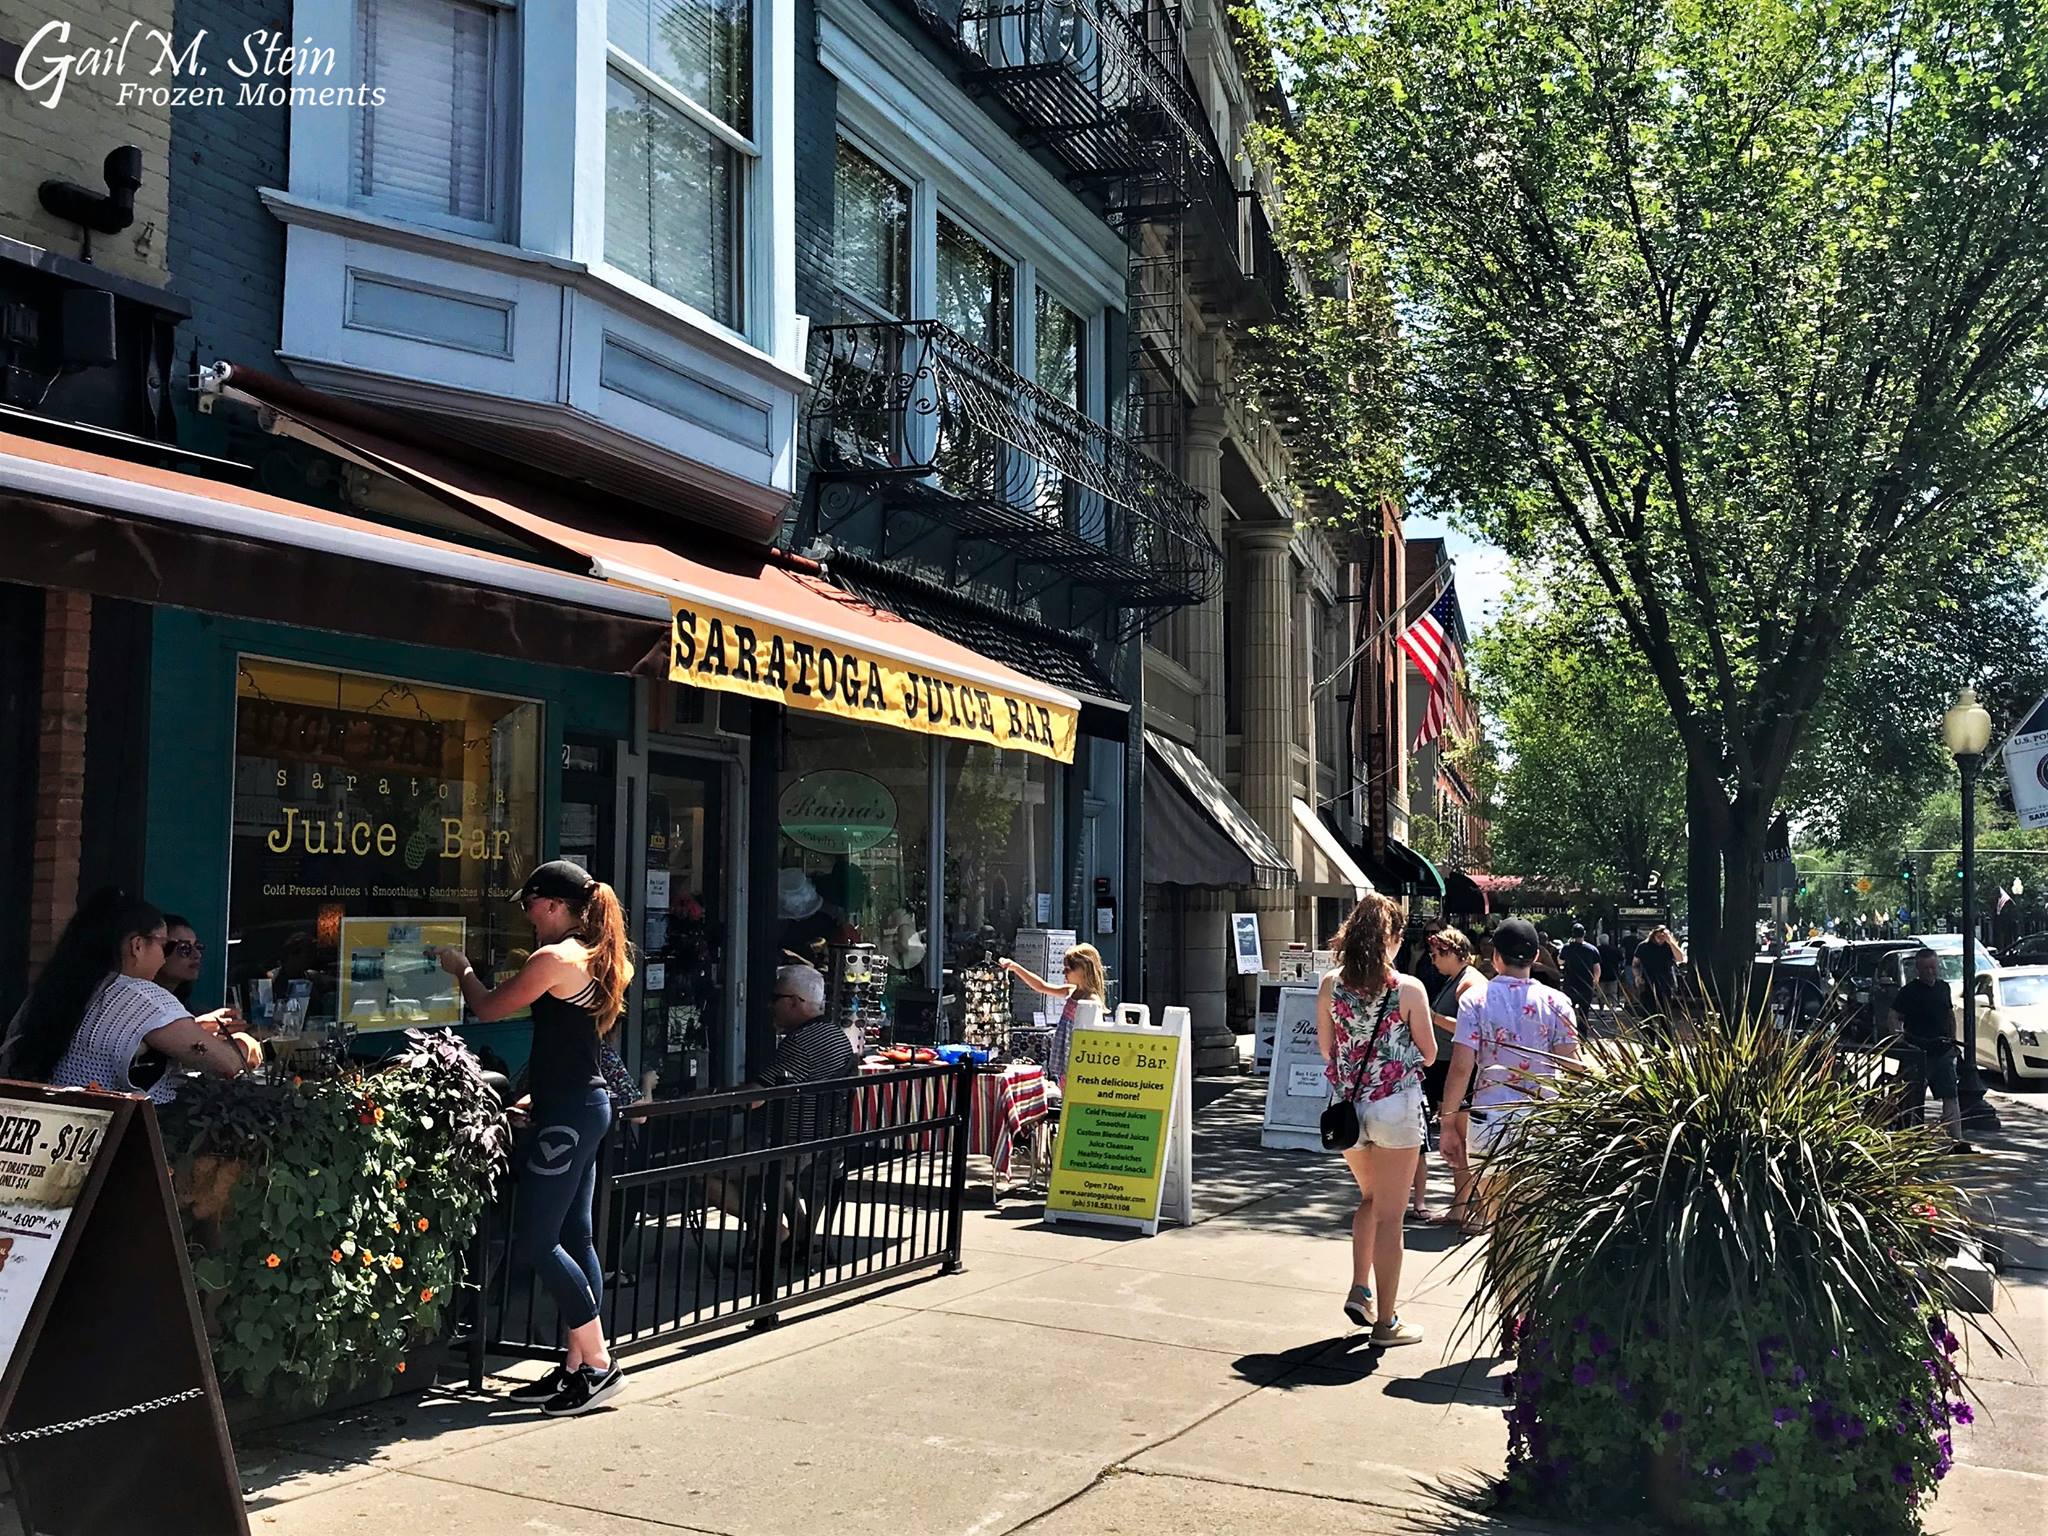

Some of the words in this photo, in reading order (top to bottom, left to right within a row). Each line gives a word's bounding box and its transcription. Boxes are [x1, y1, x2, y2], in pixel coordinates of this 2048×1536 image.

[674, 608, 887, 711] SARATOGA
[904, 671, 995, 735] JUICE
[1008, 697, 1055, 749] BAR
[786, 796, 886, 819] Raina's
[268, 807, 397, 856] Juice
[440, 817, 510, 860] Bar
[263, 883, 286, 896] Cold
[289, 884, 328, 896] Pressed
[330, 884, 361, 896] Juices
[372, 885, 419, 897] Smoothies
[429, 886, 478, 898] Sandwiches
[1081, 1039, 1168, 1052] saratoga
[1075, 1050, 1120, 1066] Juice
[1077, 1075, 1100, 1085] Fresh
[1101, 1077, 1138, 1089] delicious
[1097, 1090, 1114, 1099] and
[1115, 1092, 1141, 1101] more!
[1085, 1107, 1100, 1116] Cold
[1101, 1109, 1127, 1118] Pressed
[1127, 1111, 1147, 1120] Juices
[1095, 1119, 1130, 1129] Smoothies
[1076, 1128, 1101, 1137] Custom
[1102, 1130, 1129, 1139] Blended
[1129, 1133, 1150, 1142] Juices
[51, 1124, 99, 1164] $14
[1088, 1140, 1106, 1148] Juice
[1106, 1141, 1135, 1151] Cleanses
[1077, 1150, 1103, 1159] Healthy
[1103, 1152, 1142, 1162] Sandwiches
[6, 1160, 30, 1175] DRAFT
[27, 1164, 47, 1178] BEER
[1070, 1159, 1088, 1168] Fresh
[1088, 1161, 1110, 1170] Salads
[1124, 1165, 1147, 1174] Snacks
[15, 1177, 31, 1190] $14
[1084, 1180, 1102, 1189] Open
[1108, 1183, 1124, 1192] Days
